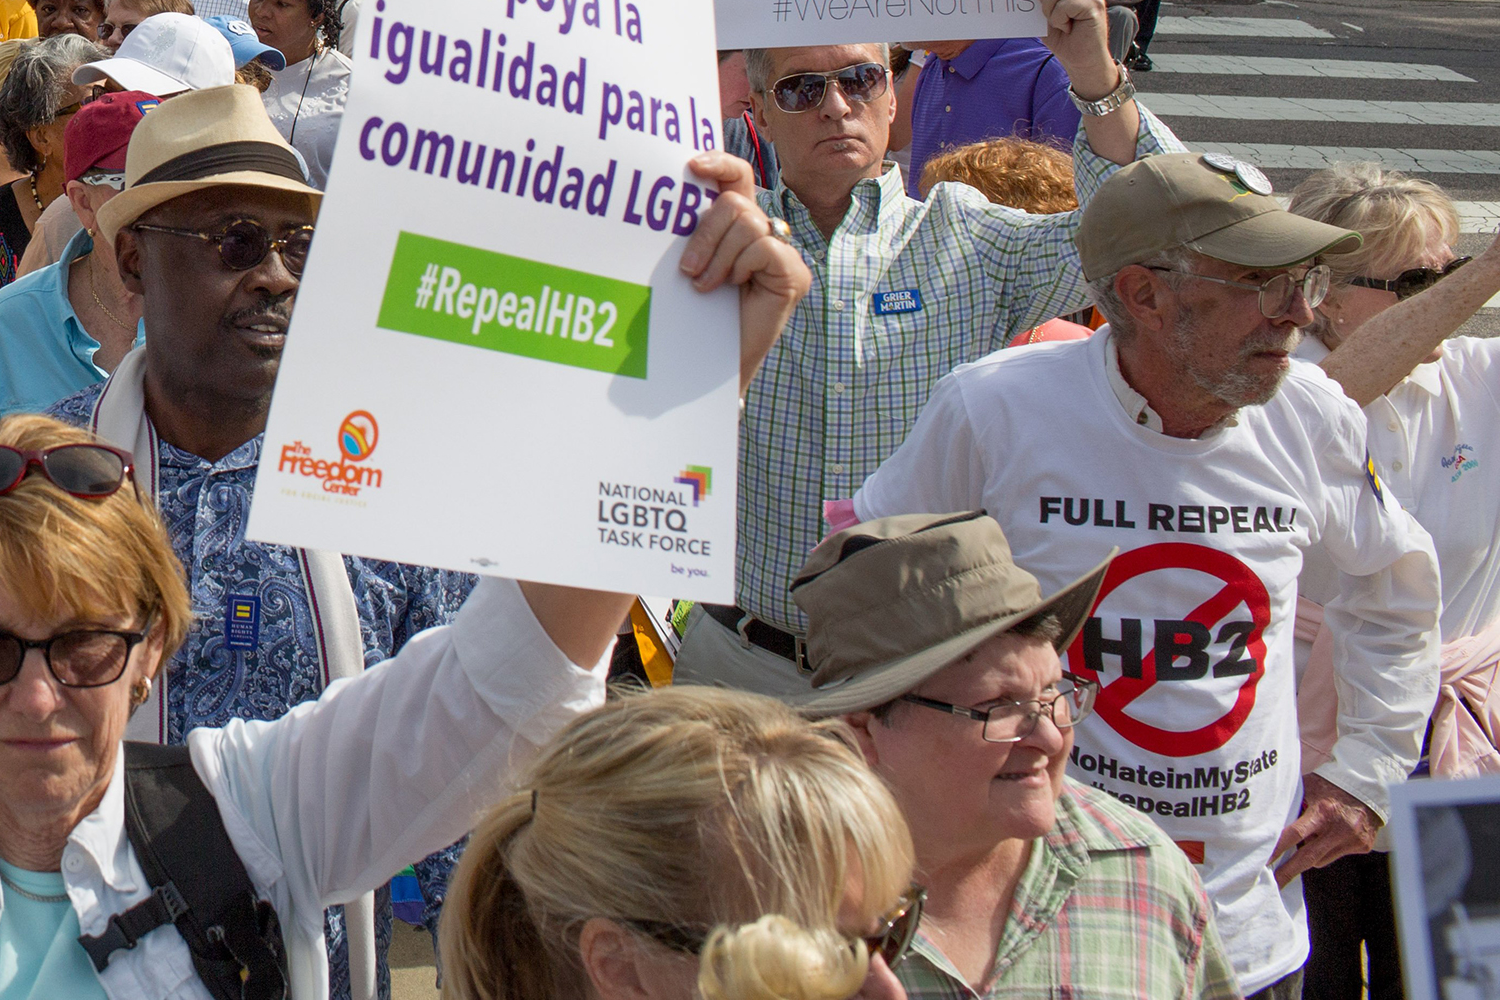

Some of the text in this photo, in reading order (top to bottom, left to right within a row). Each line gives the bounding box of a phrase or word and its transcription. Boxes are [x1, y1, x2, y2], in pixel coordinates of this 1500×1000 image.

[599, 81, 682, 145] para
[689, 96, 717, 152] la
[359, 115, 618, 218] comunidad
[415, 261, 618, 347] #RepealHB2
[880, 300, 916, 311] MARTIN
[883, 291, 911, 302] GRIER
[292, 440, 311, 457] The
[278, 445, 383, 489] Freedom
[322, 478, 362, 497] Center
[598, 481, 688, 507] NATIONAL
[597, 500, 688, 533] LGBTQ
[1039, 496, 1297, 534] FULL REPEAL!
[597, 527, 712, 557] TASK FORCE
[670, 562, 687, 576] be
[1083, 617, 1258, 681] HB2
